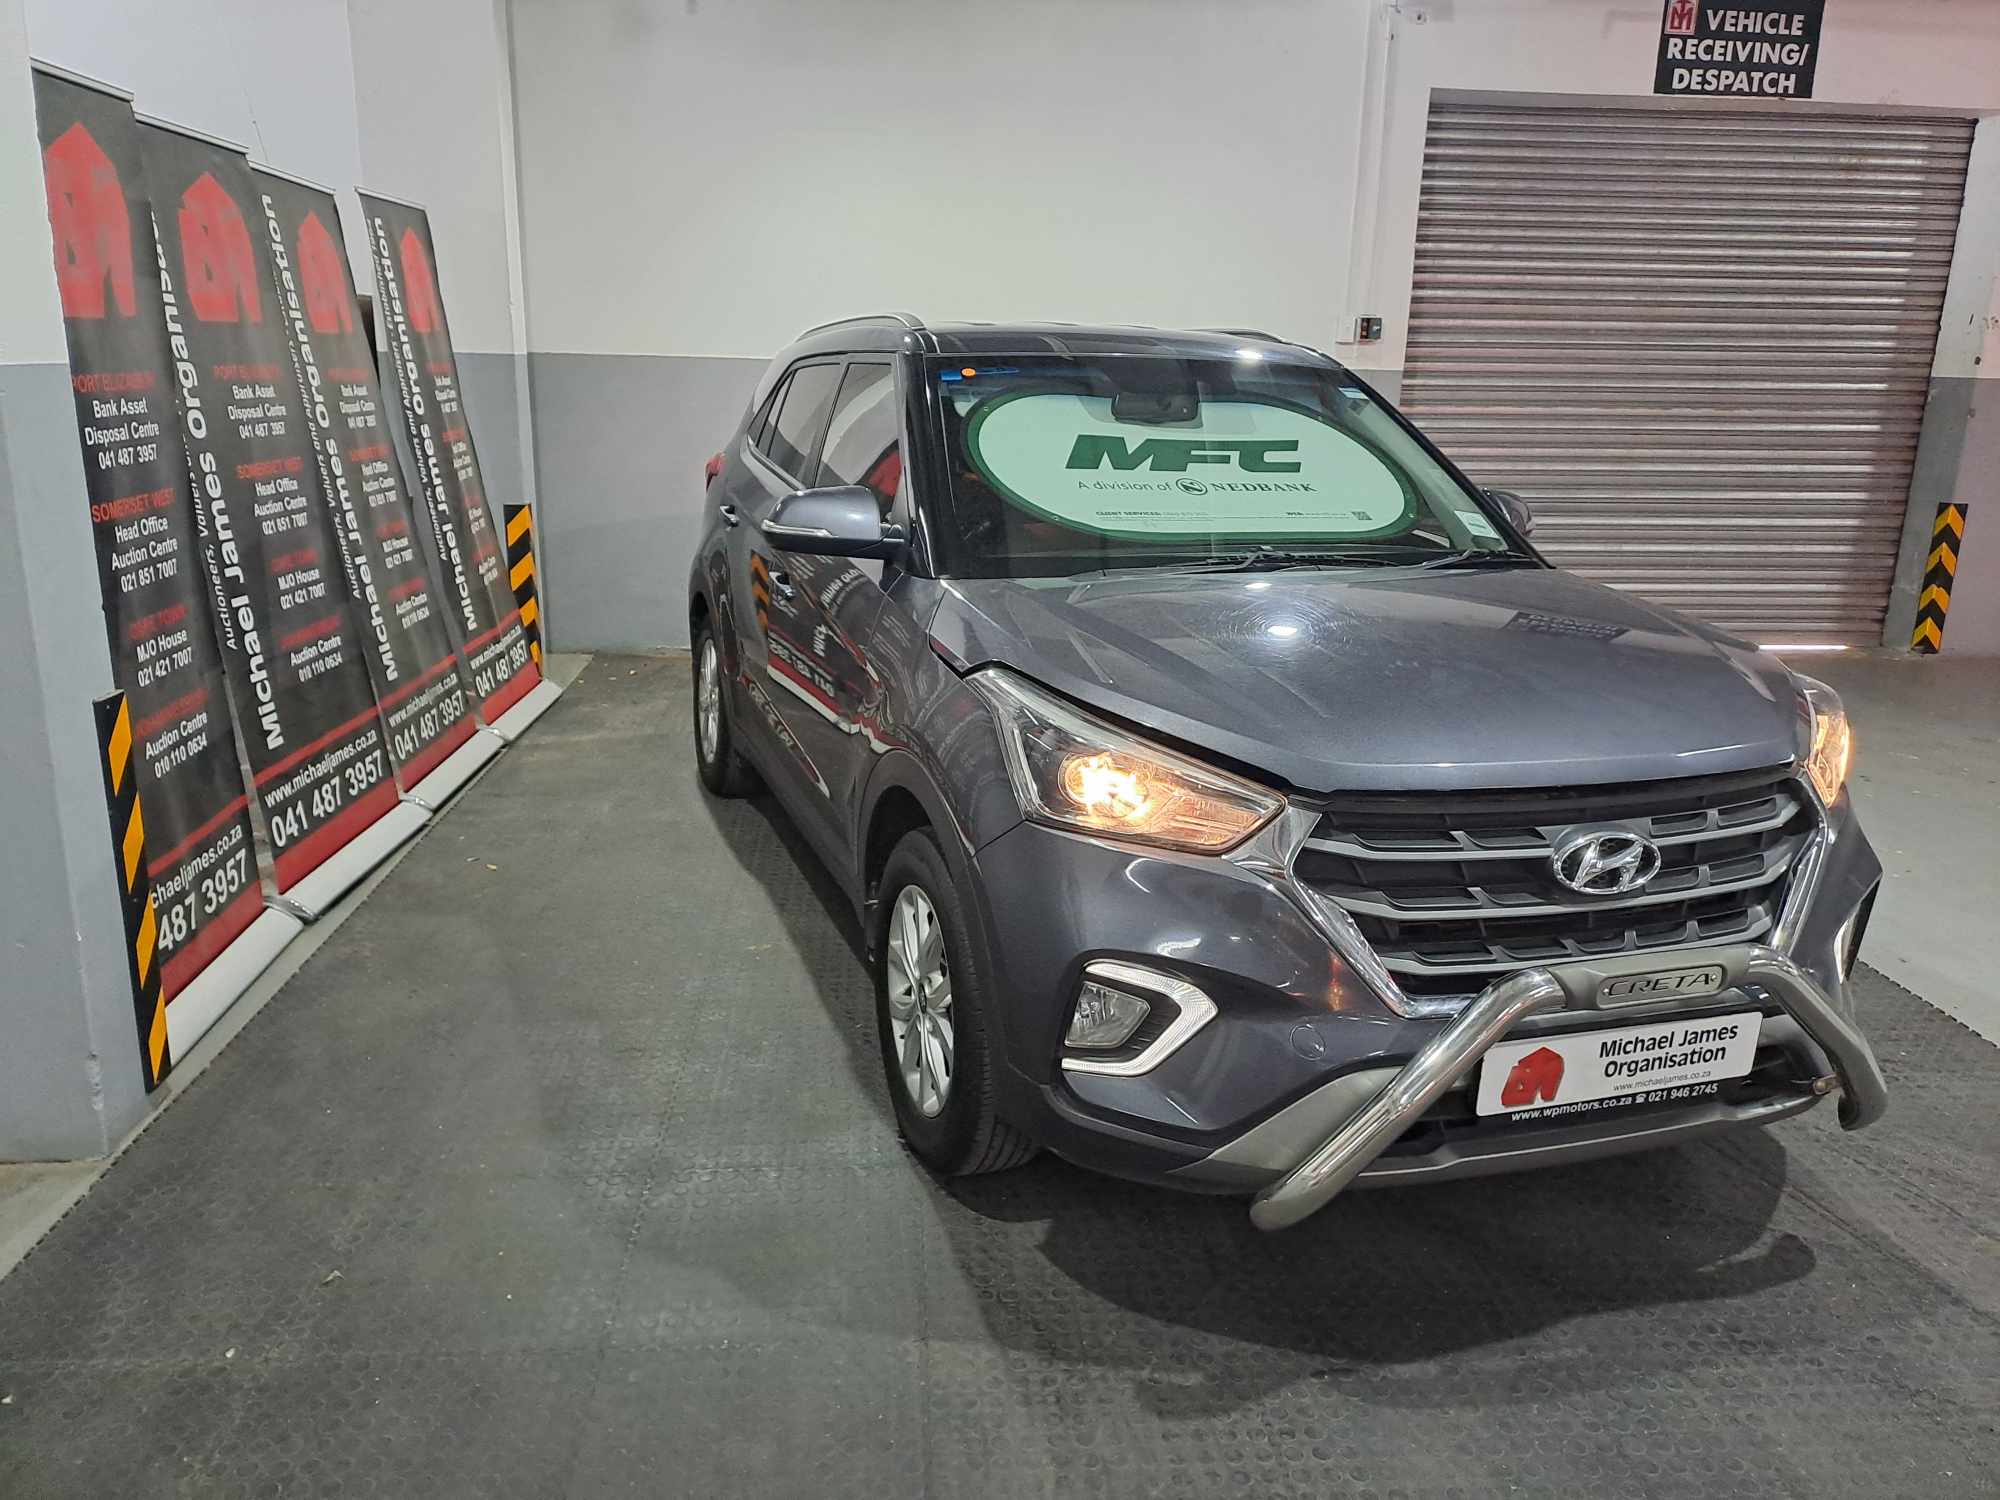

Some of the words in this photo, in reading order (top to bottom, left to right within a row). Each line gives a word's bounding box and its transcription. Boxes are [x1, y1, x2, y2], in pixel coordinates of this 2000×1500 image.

[1706, 9, 1805, 36] VEHICLE
[1666, 37, 1810, 66] RECEIVING/
[1671, 67, 1797, 94] DESPATCH
[261, 194, 330, 428] Organisation
[374, 217, 425, 415] Organisation
[92, 399, 119, 418] Bank
[120, 397, 148, 416] Asset
[232, 384, 254, 400] Bank
[227, 404, 264, 423] Disposal
[405, 410, 417, 435] and
[84, 422, 129, 447] Disposal
[130, 421, 160, 439] Centre
[308, 421, 321, 451] and
[98, 450, 116, 470] 041
[117, 447, 134, 466] 487
[137, 443, 157, 463] 3957
[412, 437, 428, 483] Valuers
[420, 423, 449, 515] James
[1064, 434, 1301, 473] MFC
[255, 481, 276, 497] Head
[276, 477, 298, 493] Office
[316, 454, 336, 508] Valuers
[325, 438, 362, 546] James
[1078, 480, 1089, 490] A
[1093, 478, 1154, 491] division
[1157, 480, 1172, 491] of
[1210, 481, 1320, 493] NEDBANK
[200, 451, 245, 584] James
[254, 499, 284, 517] Auction
[284, 496, 307, 512] Centre
[114, 521, 140, 544] Head
[140, 516, 168, 536] Office
[262, 519, 276, 535] 021
[111, 546, 148, 571] Auction
[149, 538, 178, 557] Centre
[120, 571, 138, 593] 021
[138, 565, 156, 586] 851
[156, 558, 177, 579] 7007
[295, 568, 321, 586] House
[441, 522, 477, 631] Michael
[205, 544, 238, 650] Auctioneers,
[280, 594, 295, 610] 021
[309, 583, 326, 600] 7007
[354, 554, 398, 682] Michael
[136, 639, 157, 663] MJO
[157, 629, 188, 652] House
[290, 646, 318, 667] Auction
[137, 666, 154, 687] 021
[155, 657, 171, 678] 421
[173, 647, 192, 670] 7007
[231, 594, 285, 750] Michael
[475, 671, 496, 698] 041
[495, 655, 511, 680] 487
[509, 639, 528, 670] 3957
[145, 728, 180, 760] Auction
[180, 711, 208, 737] Centre
[394, 723, 420, 761] 041
[420, 707, 440, 741] 487
[439, 689, 464, 726] 3957
[154, 755, 169, 779] 010
[171, 746, 186, 767] 110
[188, 733, 208, 758] 0634
[264, 729, 378, 809] www.michaeljames.co.za
[271, 799, 309, 848] 041
[312, 775, 342, 819] 487
[344, 750, 384, 797] 3957
[151, 824, 243, 909] chaeljames.co.za
[158, 891, 197, 951] 487
[201, 848, 247, 914] 3957
[1607, 971, 1713, 997] CRETA
[1599, 1031, 1676, 1058] Michael
[1679, 1023, 1739, 1047] James
[1603, 1044, 1727, 1080] Organisation
[1612, 1070, 1712, 1092] www.michaeljames.co.za
[1511, 1096, 1632, 1122] www.wpmotors.co.za
[1648, 1088, 1668, 1103] 021
[1670, 1086, 1690, 1100] 946
[1691, 1082, 1719, 1097] 2745
